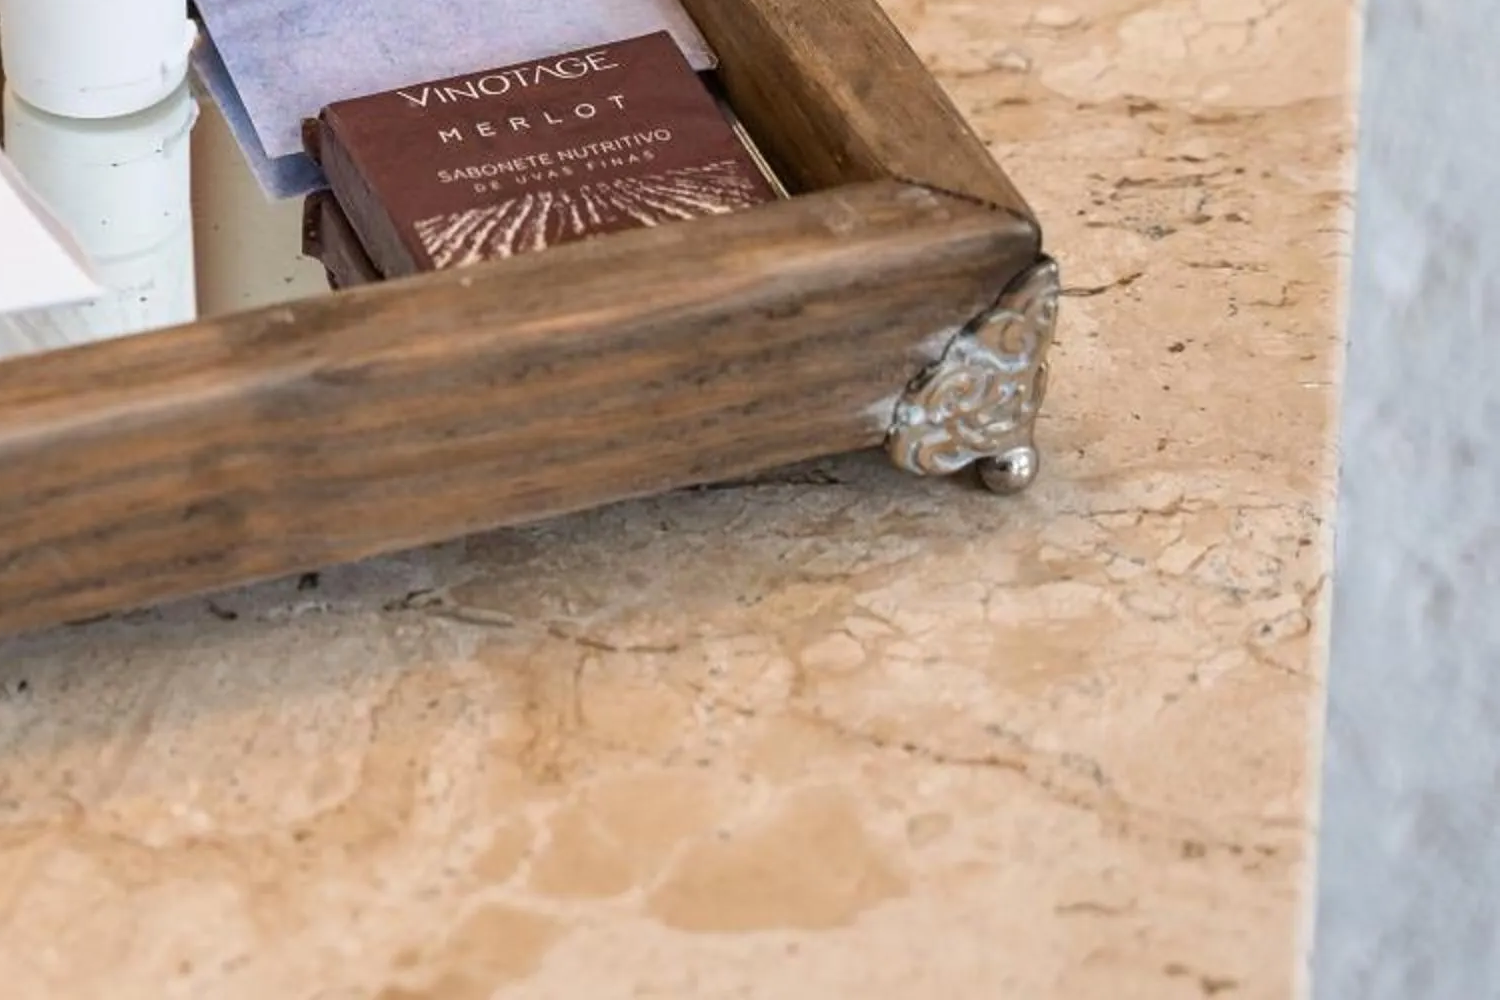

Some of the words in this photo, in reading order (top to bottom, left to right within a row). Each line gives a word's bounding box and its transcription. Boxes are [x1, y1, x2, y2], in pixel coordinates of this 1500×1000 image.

[396, 48, 619, 108] VINOTAGE
[437, 94, 627, 144] MERLOT
[437, 152, 553, 184] SABONETE
[556, 127, 672, 161] NUTRITIVO
[473, 182, 501, 194] DE
